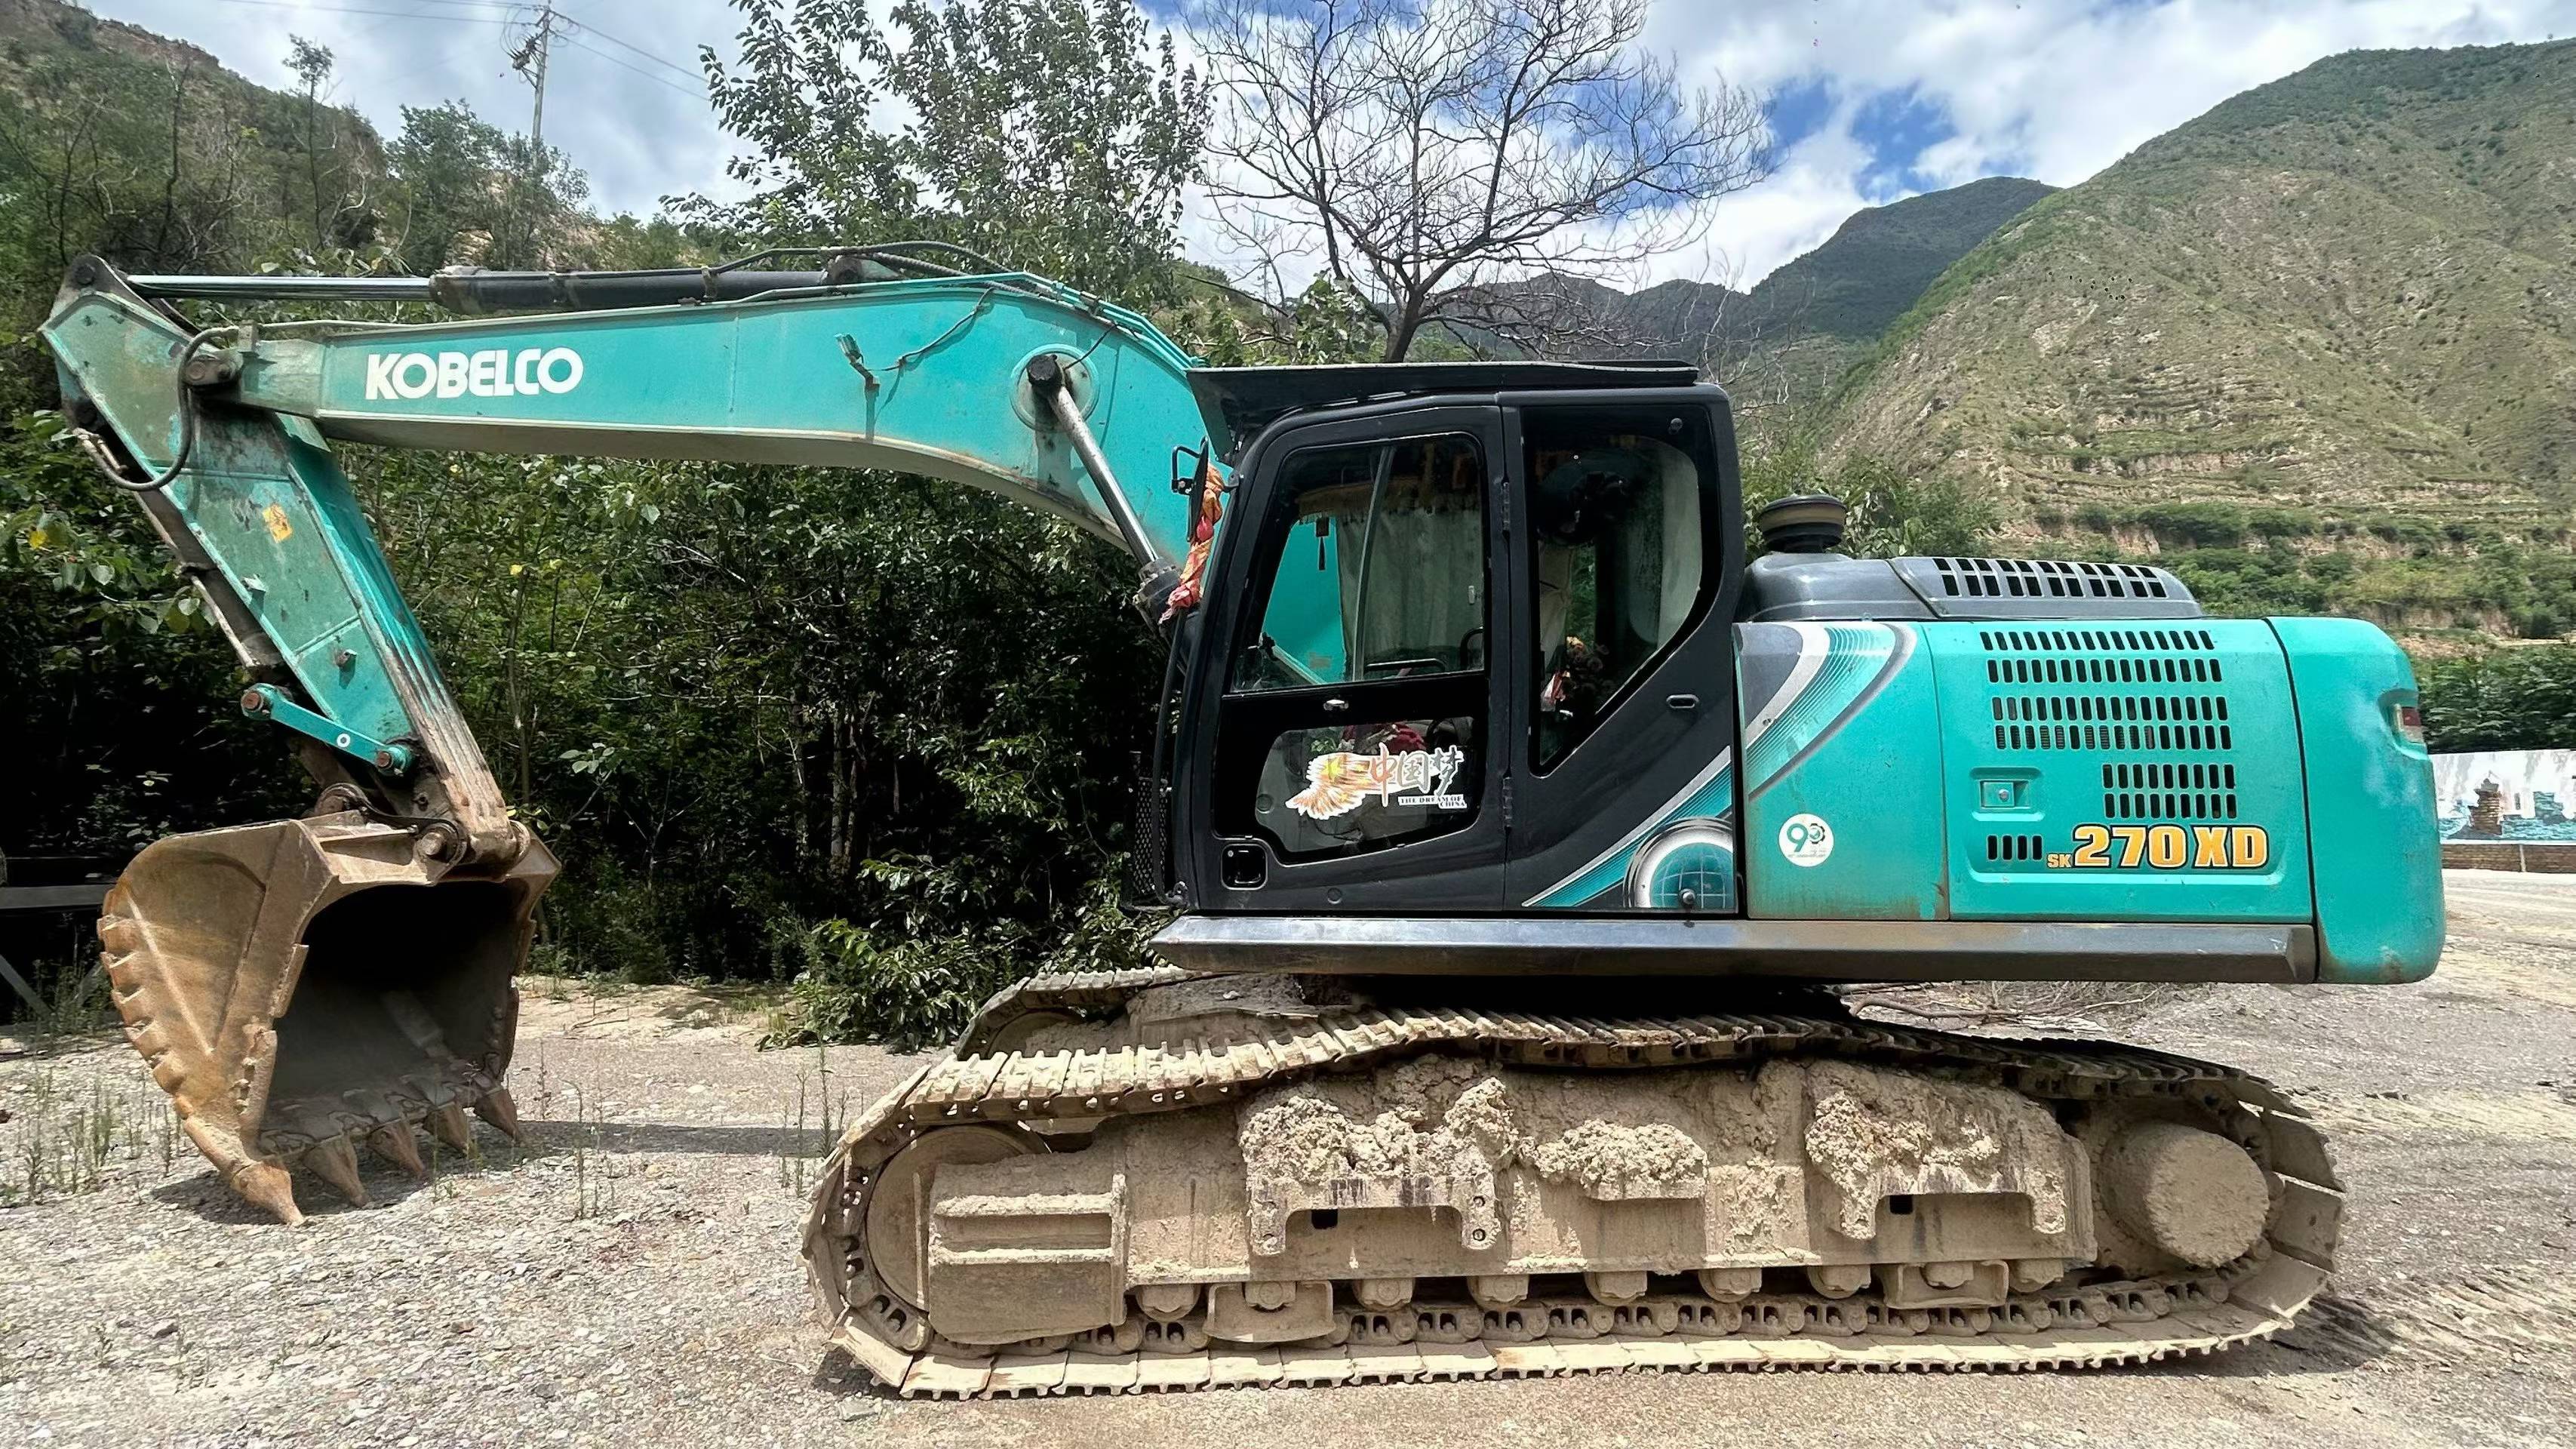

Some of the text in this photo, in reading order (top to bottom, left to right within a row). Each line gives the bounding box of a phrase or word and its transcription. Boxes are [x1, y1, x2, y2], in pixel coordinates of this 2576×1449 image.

[365, 347, 584, 400] KOBELCO
[1370, 743, 1464, 807] 中国梦
[2046, 824, 2269, 869] SK 270 XD
